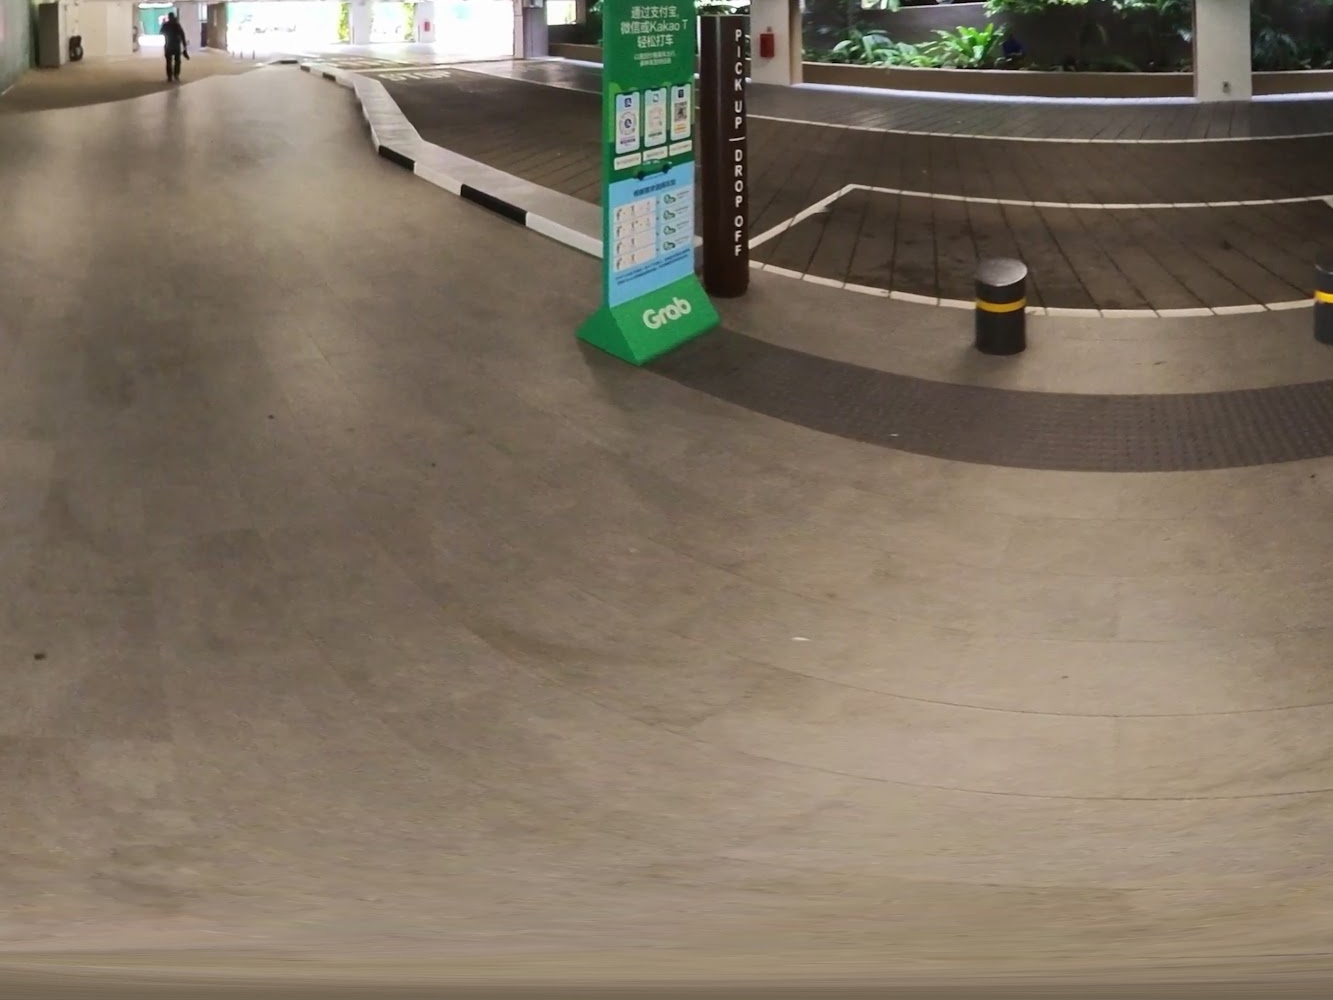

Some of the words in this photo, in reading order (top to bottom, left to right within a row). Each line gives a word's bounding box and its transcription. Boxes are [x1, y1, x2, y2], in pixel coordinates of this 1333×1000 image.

[637, 34, 674, 49] 轻松打车
[734, 28, 743, 92] PICK
[734, 100, 743, 130] UP
[734, 149, 744, 208] DROP
[734, 215, 744, 257] OFF
[643, 296, 692, 330] Grab
